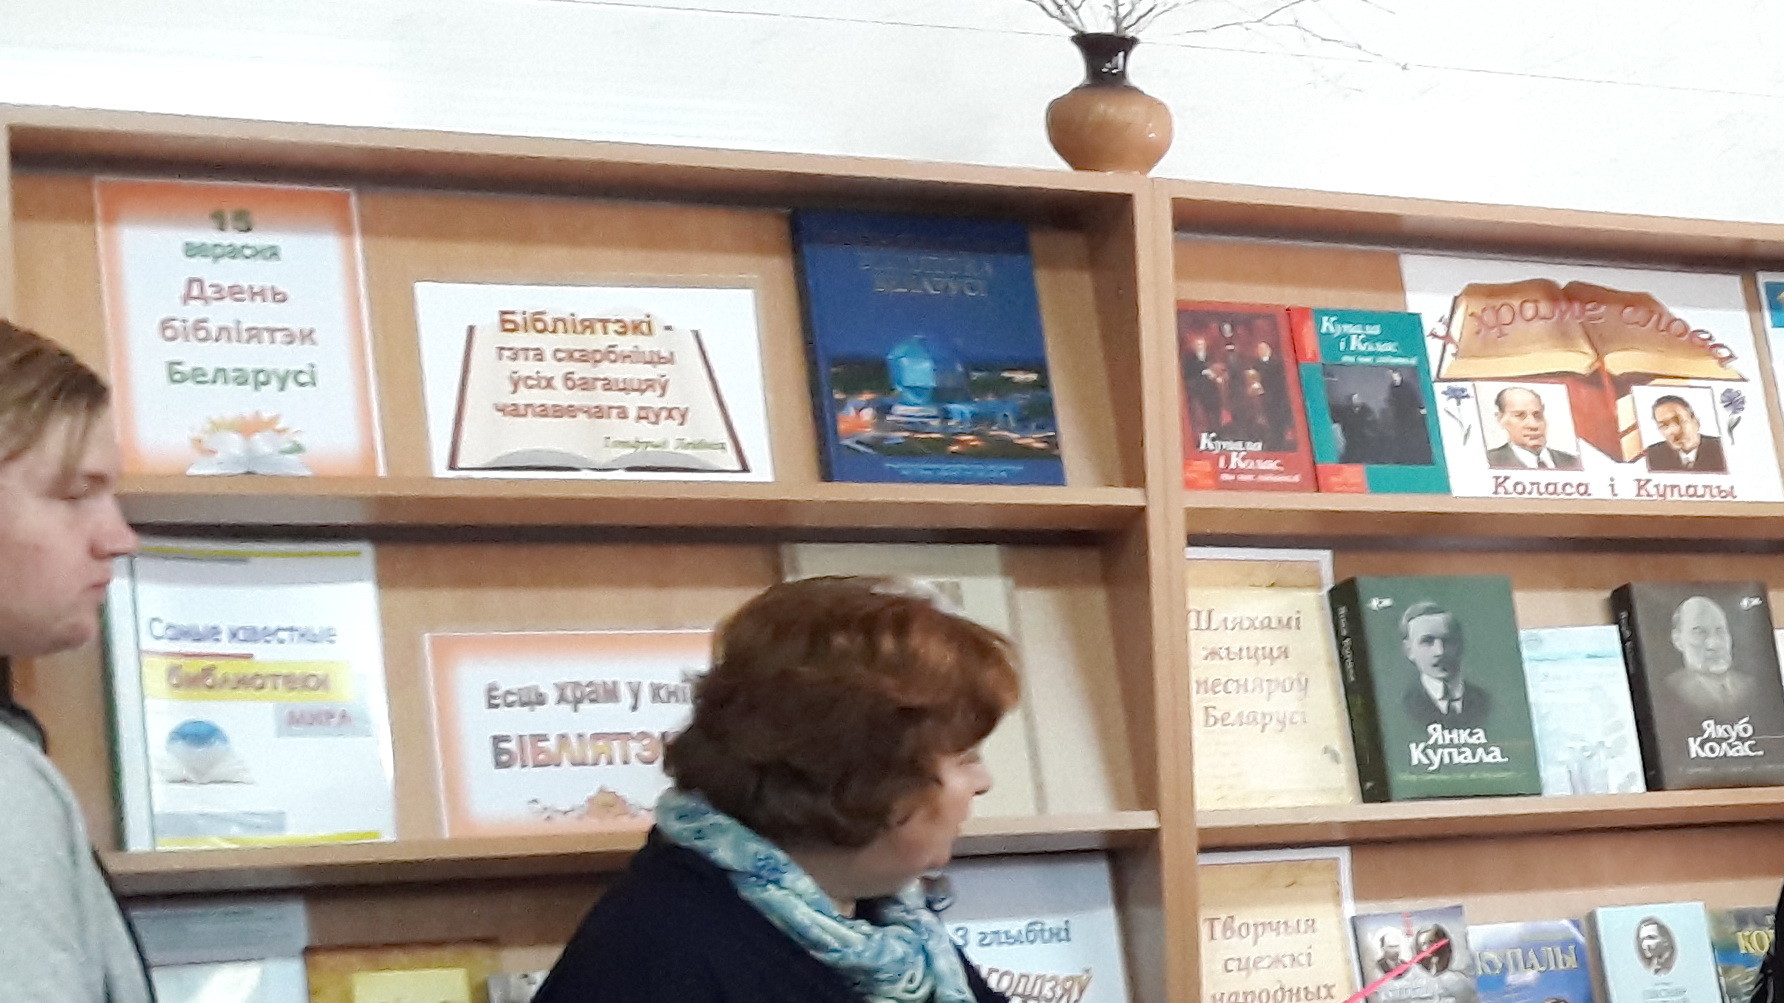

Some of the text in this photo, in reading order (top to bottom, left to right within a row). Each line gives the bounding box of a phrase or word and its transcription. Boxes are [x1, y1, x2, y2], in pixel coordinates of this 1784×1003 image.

[181, 276, 290, 306] Дзень
[159, 316, 320, 346] бібліятэк
[498, 310, 654, 336] Бібліятэкі
[496, 343, 676, 368] гэта скарбніцы
[164, 359, 318, 393] Беларусі
[509, 370, 670, 398] ўсіх багаццяў
[494, 402, 690, 427] чалавечага духу
[1491, 475, 1738, 501] Коласа і Купалы
[1186, 608, 1302, 632] Шляхамі
[1202, 646, 1290, 667] жыцця
[485, 680, 692, 713] Есць храм у кні
[1195, 671, 1309, 702] песняроў
[1203, 705, 1308, 733] Беларусі
[1701, 716, 1754, 741] Якуб
[1426, 723, 1488, 746] Янка
[977, 919, 1072, 946] глыбіні
[1203, 915, 1316, 947] Творчыя
[1223, 944, 1313, 977] сцежкі
